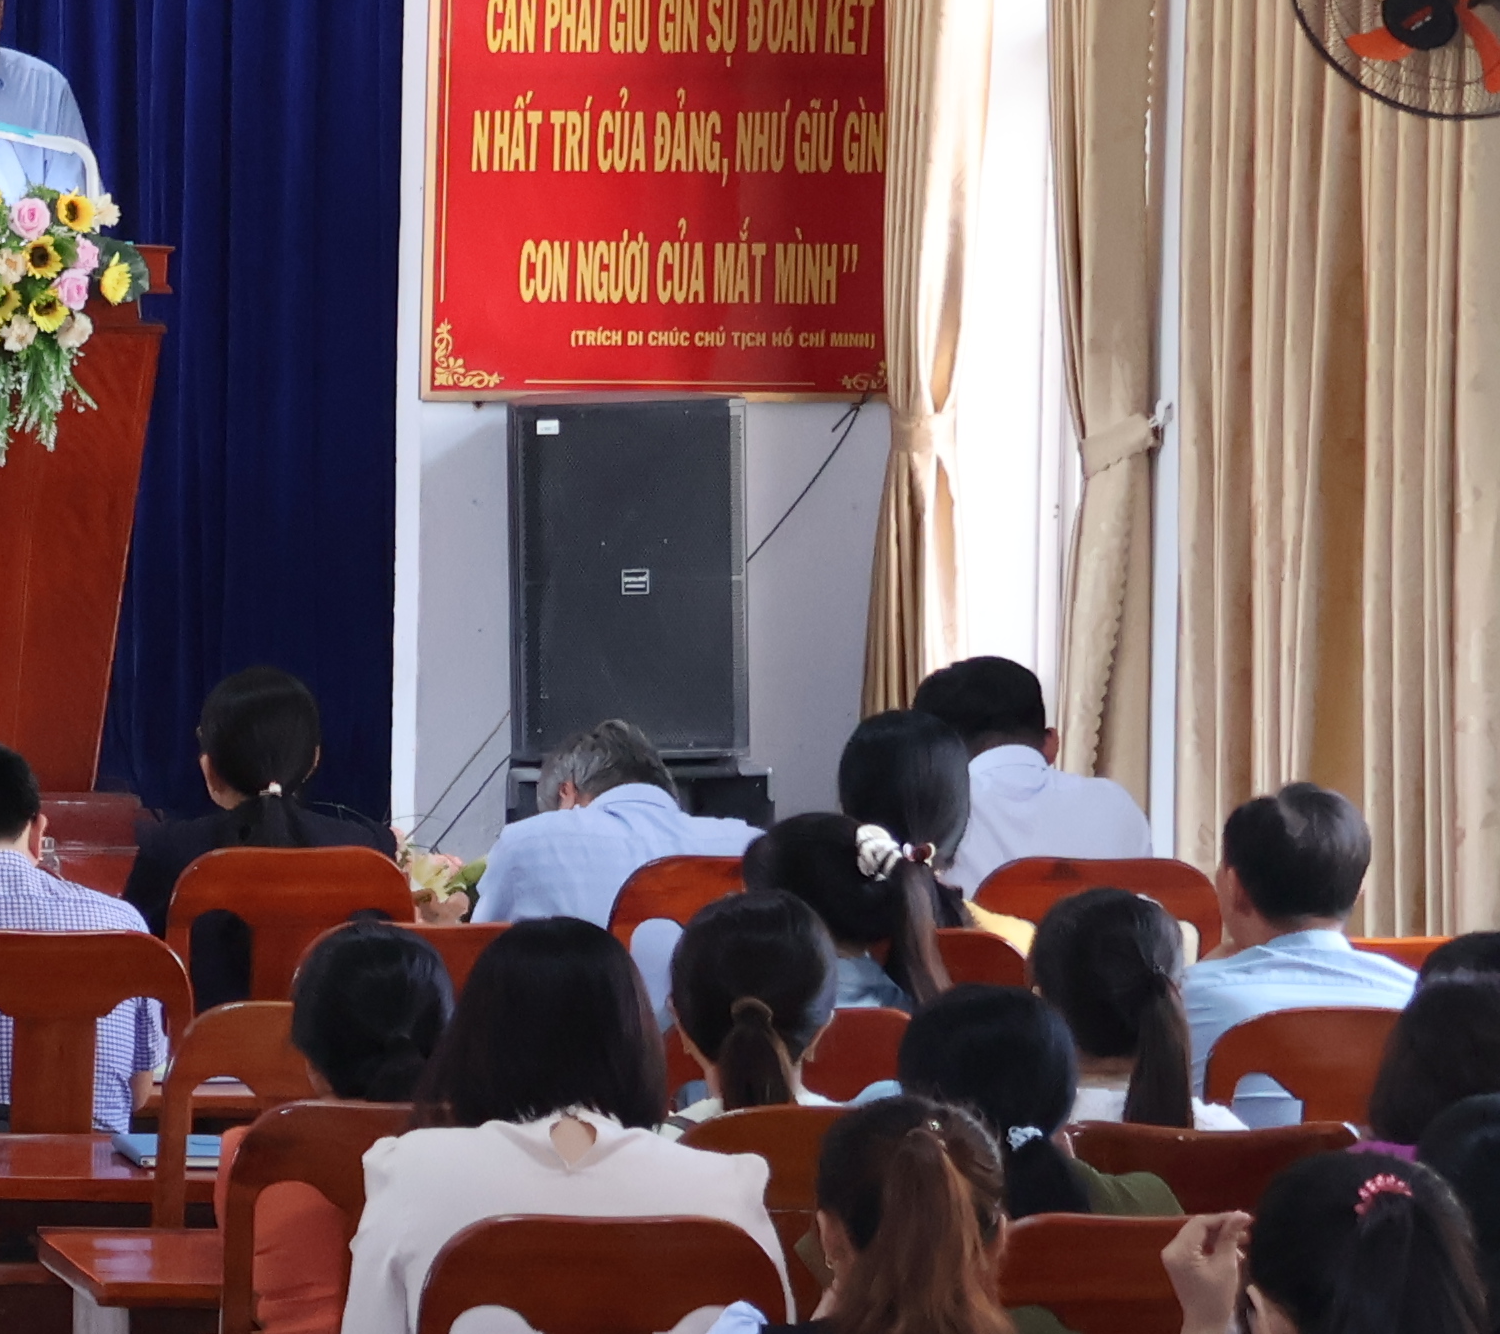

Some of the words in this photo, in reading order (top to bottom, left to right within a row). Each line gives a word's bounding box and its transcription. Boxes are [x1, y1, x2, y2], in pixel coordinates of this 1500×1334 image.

[472, 91, 542, 172] NHẤT
[550, 96, 592, 171] TRÍ
[597, 87, 645, 172] CỦA
[654, 88, 728, 186] ĐẢNG,
[735, 99, 790, 172] NHƯ
[520, 240, 569, 303] CON
[657, 218, 704, 304] CỦA
[714, 217, 766, 303] MẮT
